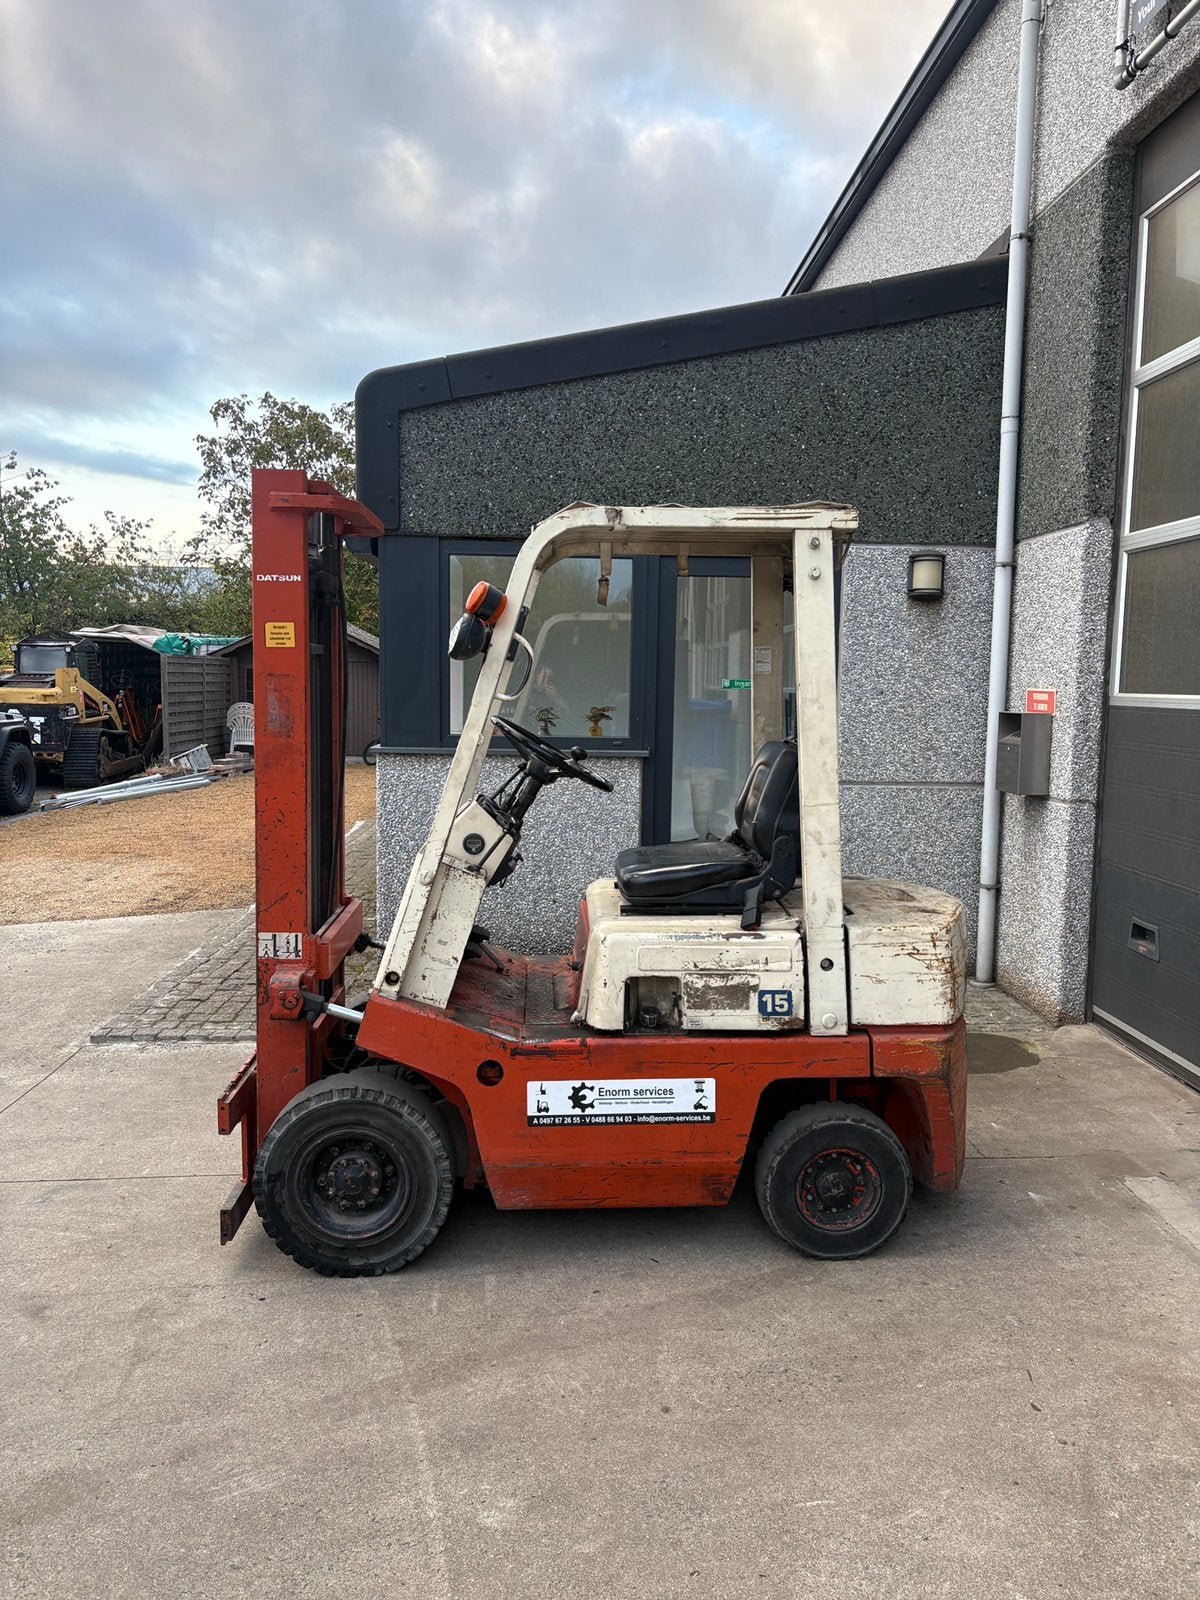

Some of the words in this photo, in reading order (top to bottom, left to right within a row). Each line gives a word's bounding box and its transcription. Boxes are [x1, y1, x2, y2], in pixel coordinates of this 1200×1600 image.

[761, 993, 789, 1013] 15
[598, 1087, 631, 1096] Enorm
[633, 1086, 674, 1096] services
[637, 1115, 711, 1123] info@enorm-services.be
